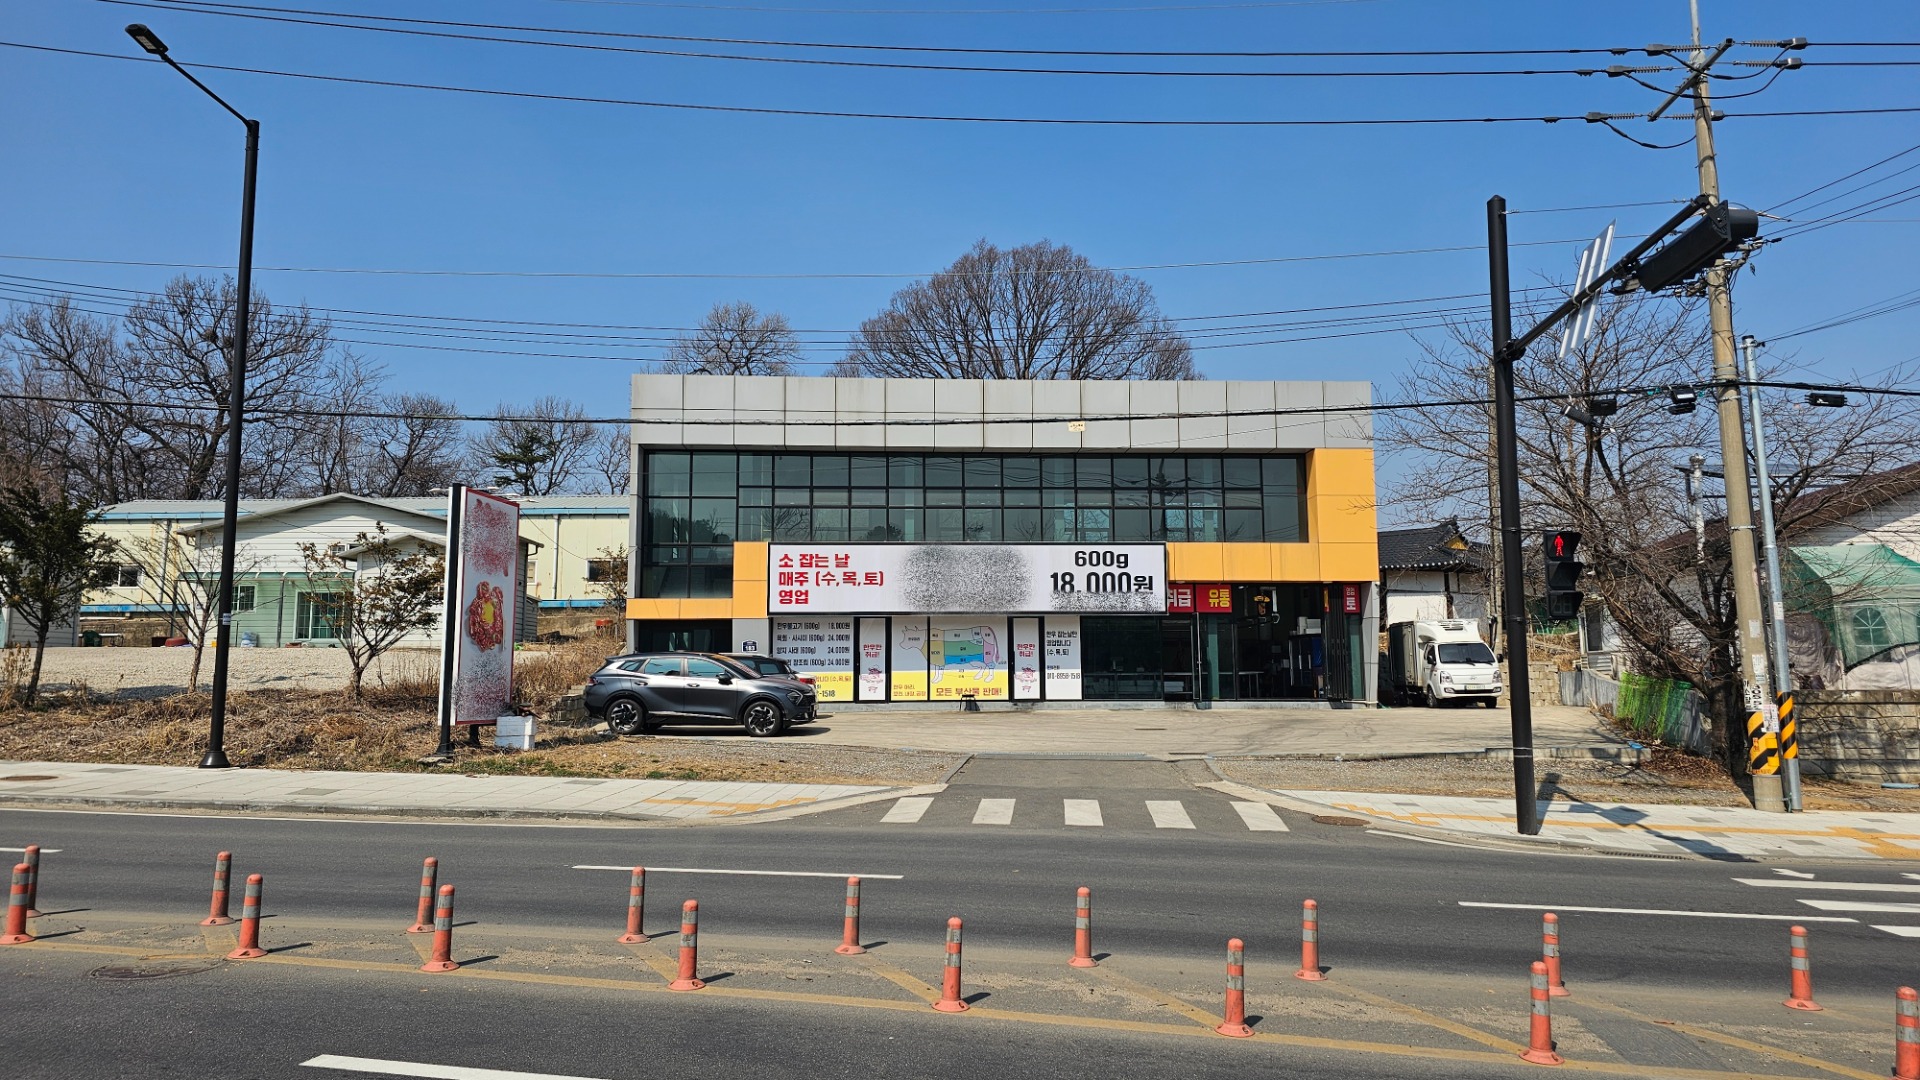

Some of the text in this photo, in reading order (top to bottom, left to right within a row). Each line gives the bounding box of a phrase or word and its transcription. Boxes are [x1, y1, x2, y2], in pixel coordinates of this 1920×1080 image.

[779, 553, 850, 568] 소 잡는 날
[1074, 551, 1129, 569] 600g
[779, 571, 809, 586] 매주
[779, 589, 809, 605] 영업
[1208, 588, 1230, 607] 유통
[936, 688, 952, 696] 모든
